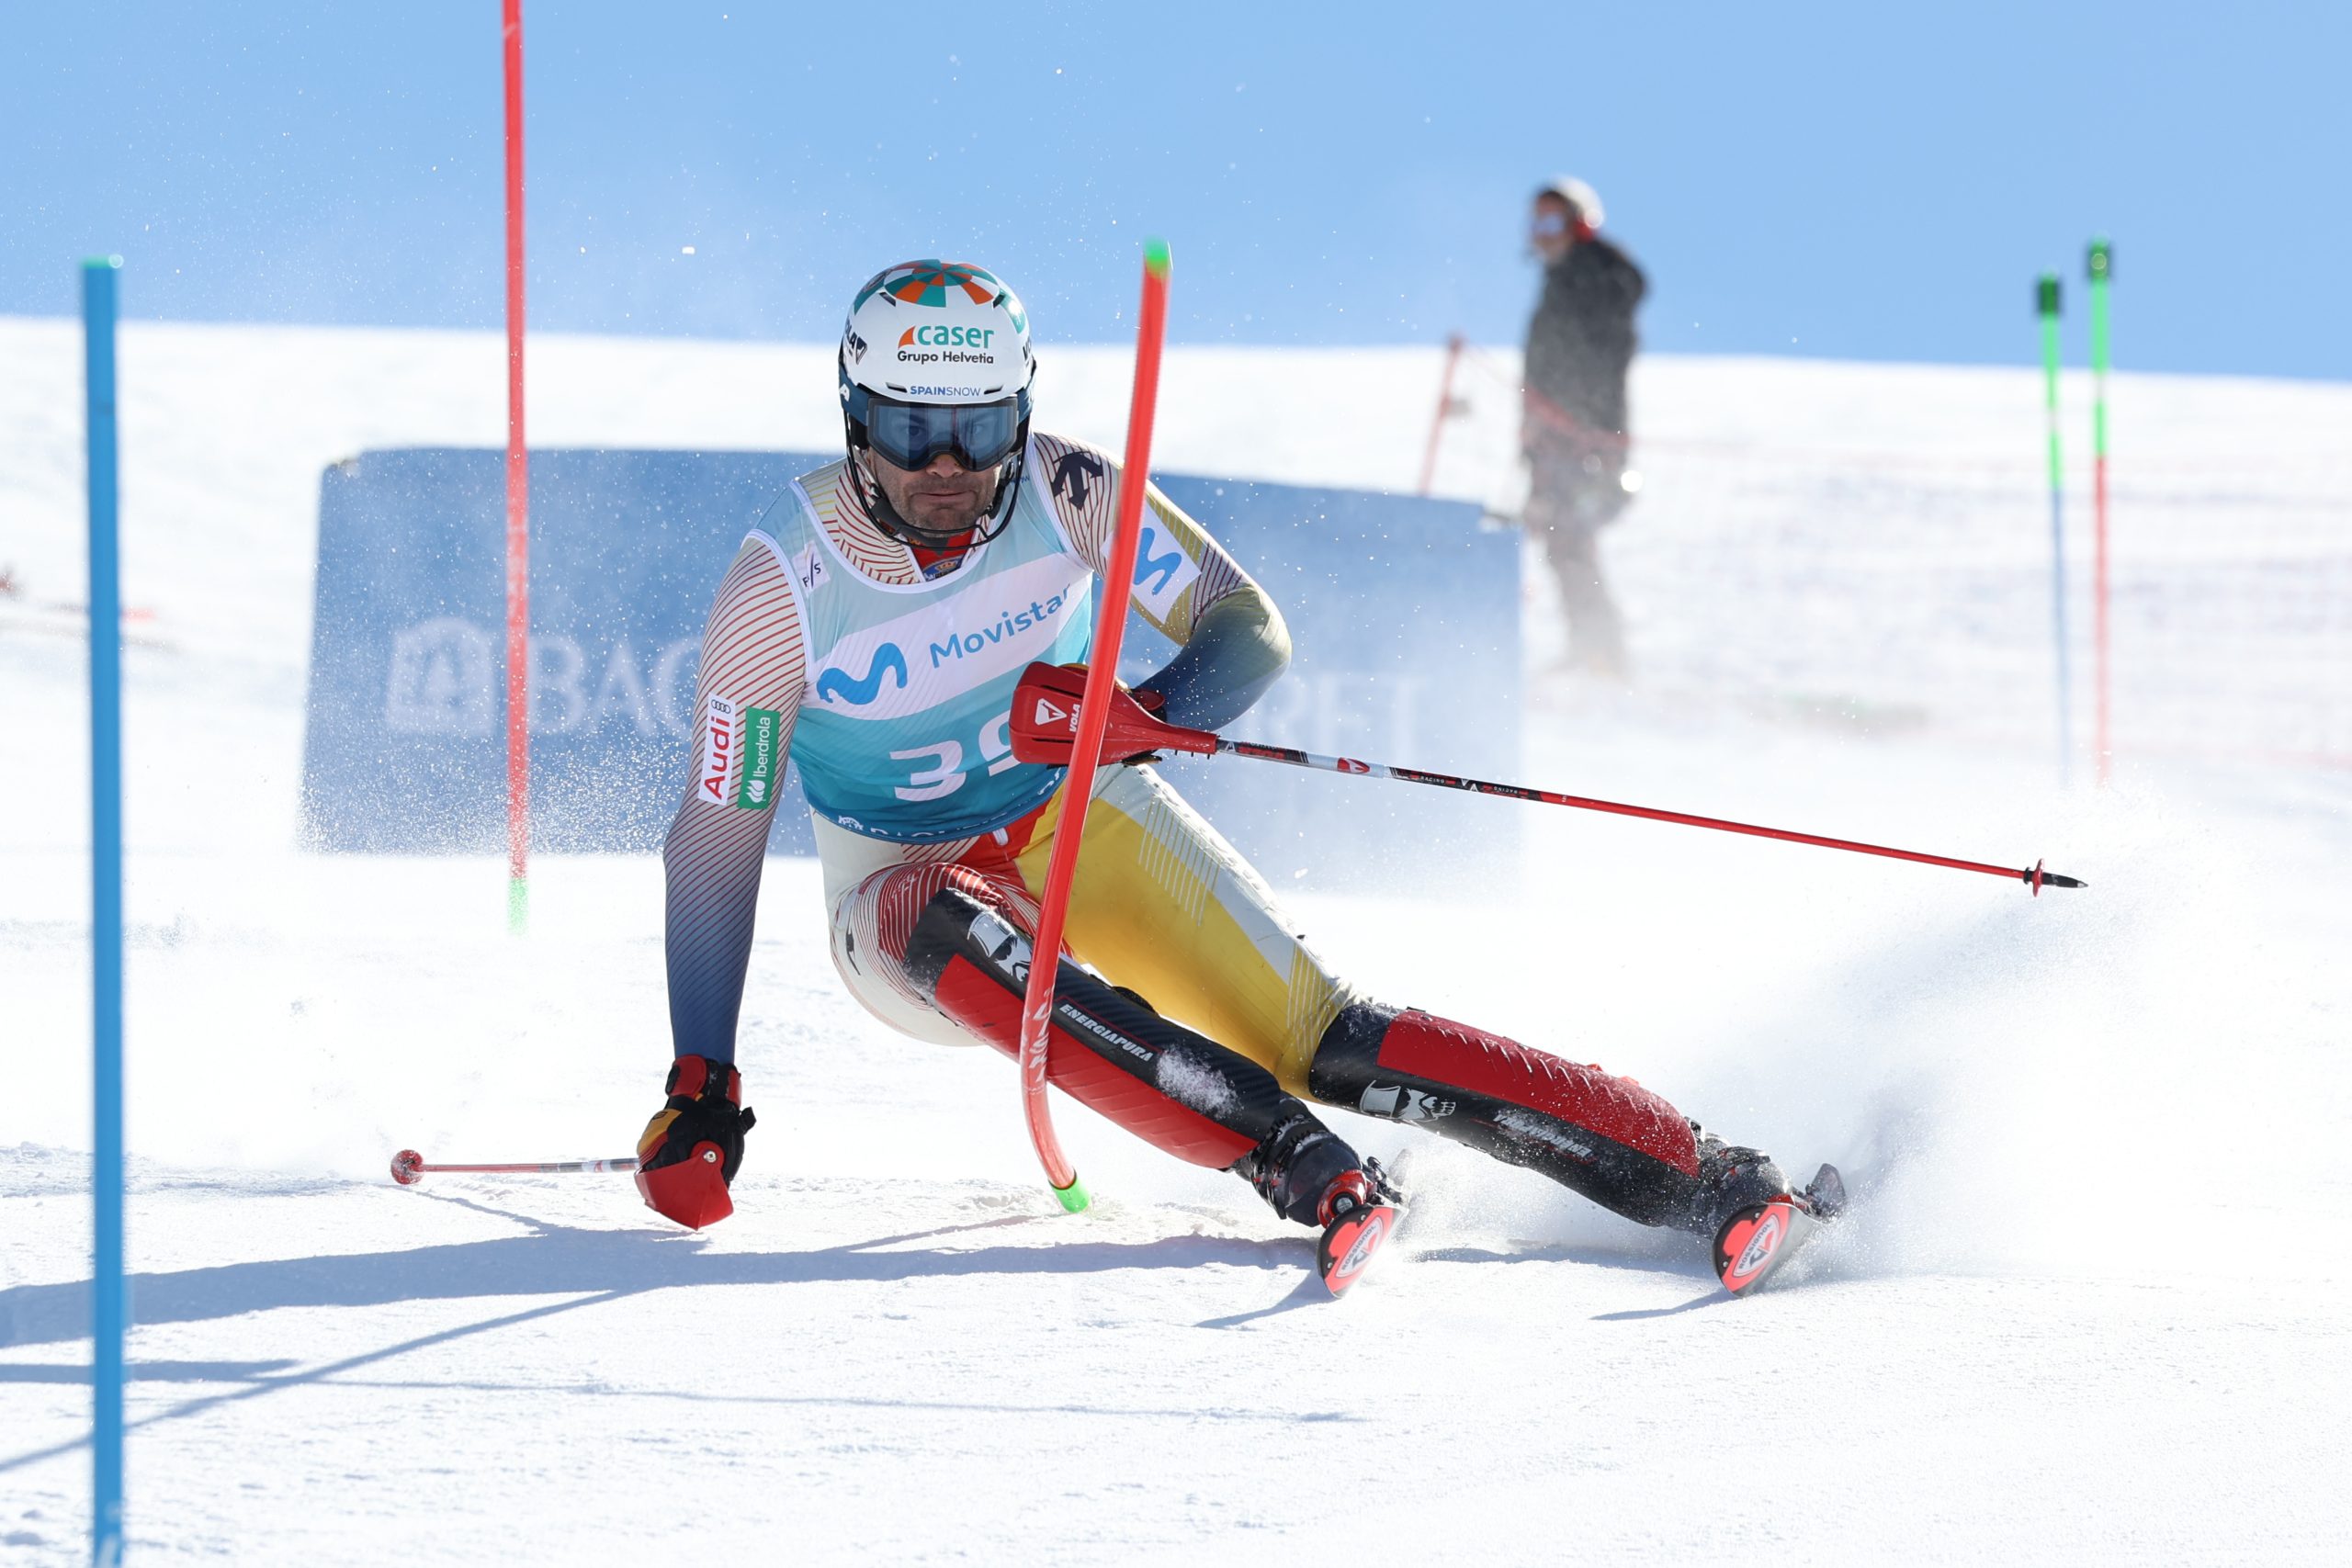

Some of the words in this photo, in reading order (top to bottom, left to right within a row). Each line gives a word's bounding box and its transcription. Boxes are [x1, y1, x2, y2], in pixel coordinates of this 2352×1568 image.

[897, 350, 939, 366] Grupo
[943, 351, 994, 365] Helvetia
[917, 325, 995, 349] caser
[910, 386, 981, 397] SPAINSNOW
[929, 583, 1071, 669] Movistar
[1069, 703, 1081, 733] VOLA
[704, 715, 731, 800] Audi
[752, 716, 772, 778] Iberdrola
[1059, 1003, 1154, 1063] ENERGIAPURA
[1341, 1224, 1377, 1271] ROSSIGNOL
[1738, 1223, 1771, 1269] ROSSIGNOL
